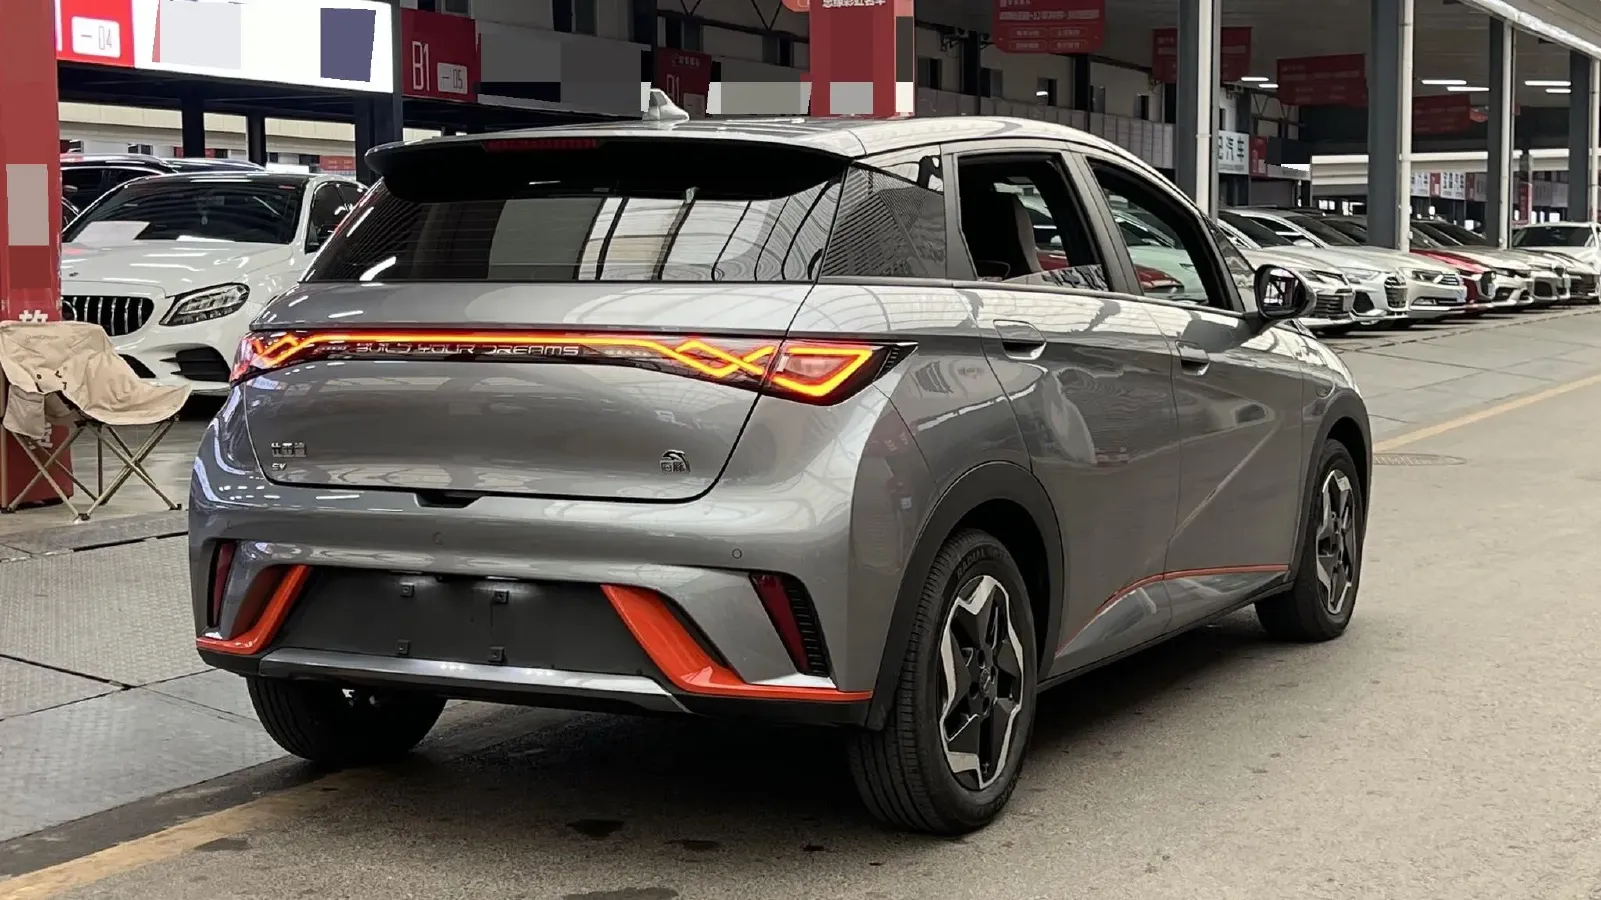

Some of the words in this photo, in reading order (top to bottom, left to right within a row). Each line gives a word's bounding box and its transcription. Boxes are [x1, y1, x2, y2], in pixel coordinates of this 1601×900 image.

[412, 41, 430, 91] B1
[418, 343, 474, 354] YOUR
[487, 343, 579, 356] DREAMS
